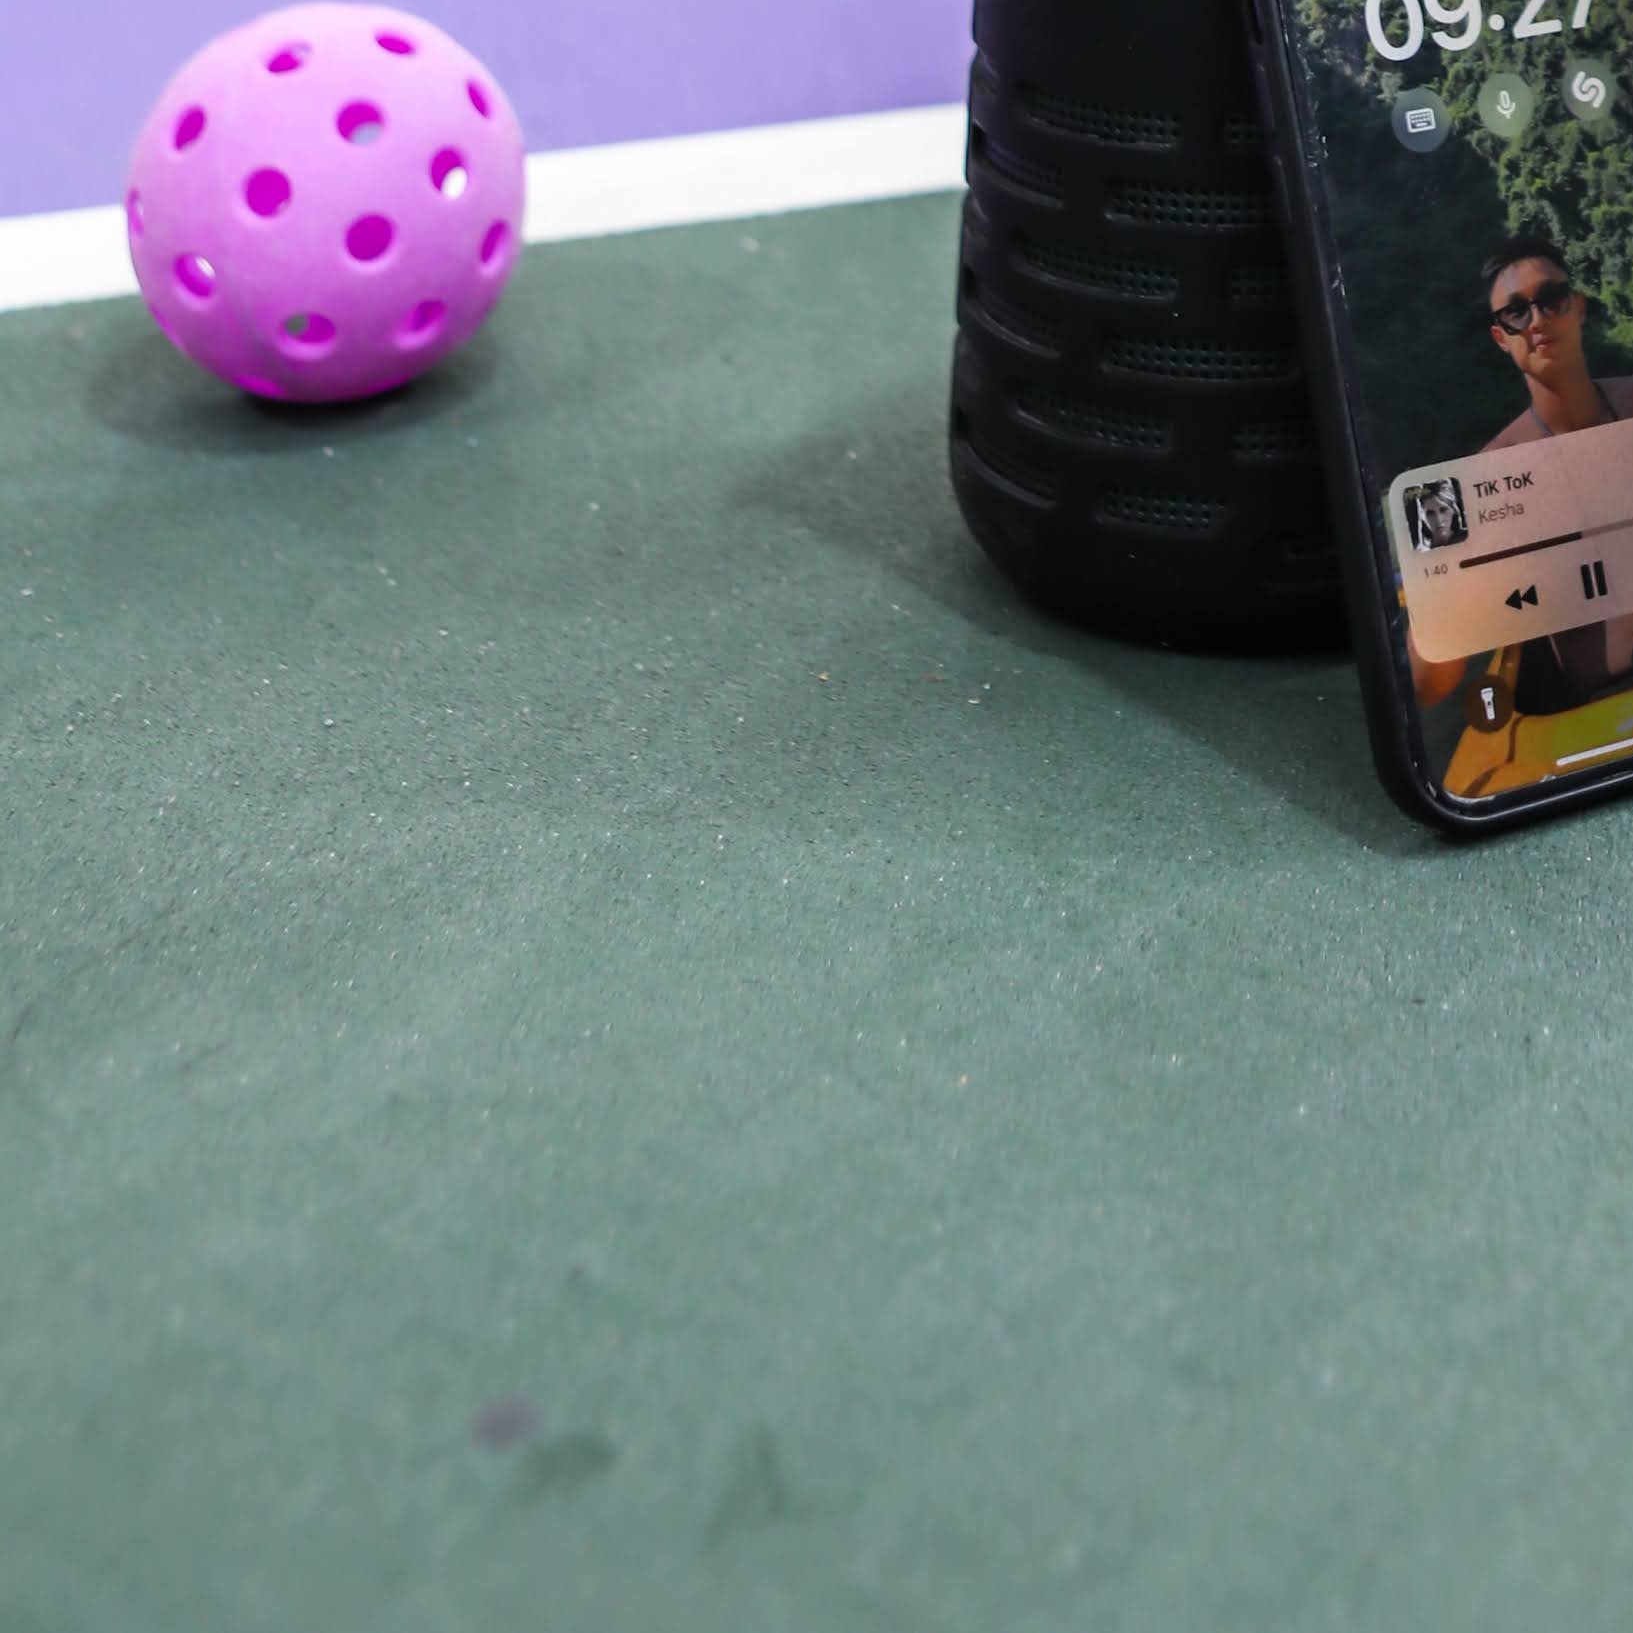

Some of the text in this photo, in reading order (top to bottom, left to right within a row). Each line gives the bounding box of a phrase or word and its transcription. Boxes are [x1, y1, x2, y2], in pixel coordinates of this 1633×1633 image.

[1473, 471, 1534, 498] TiK ToK
[1478, 502, 1525, 524] Kesha
